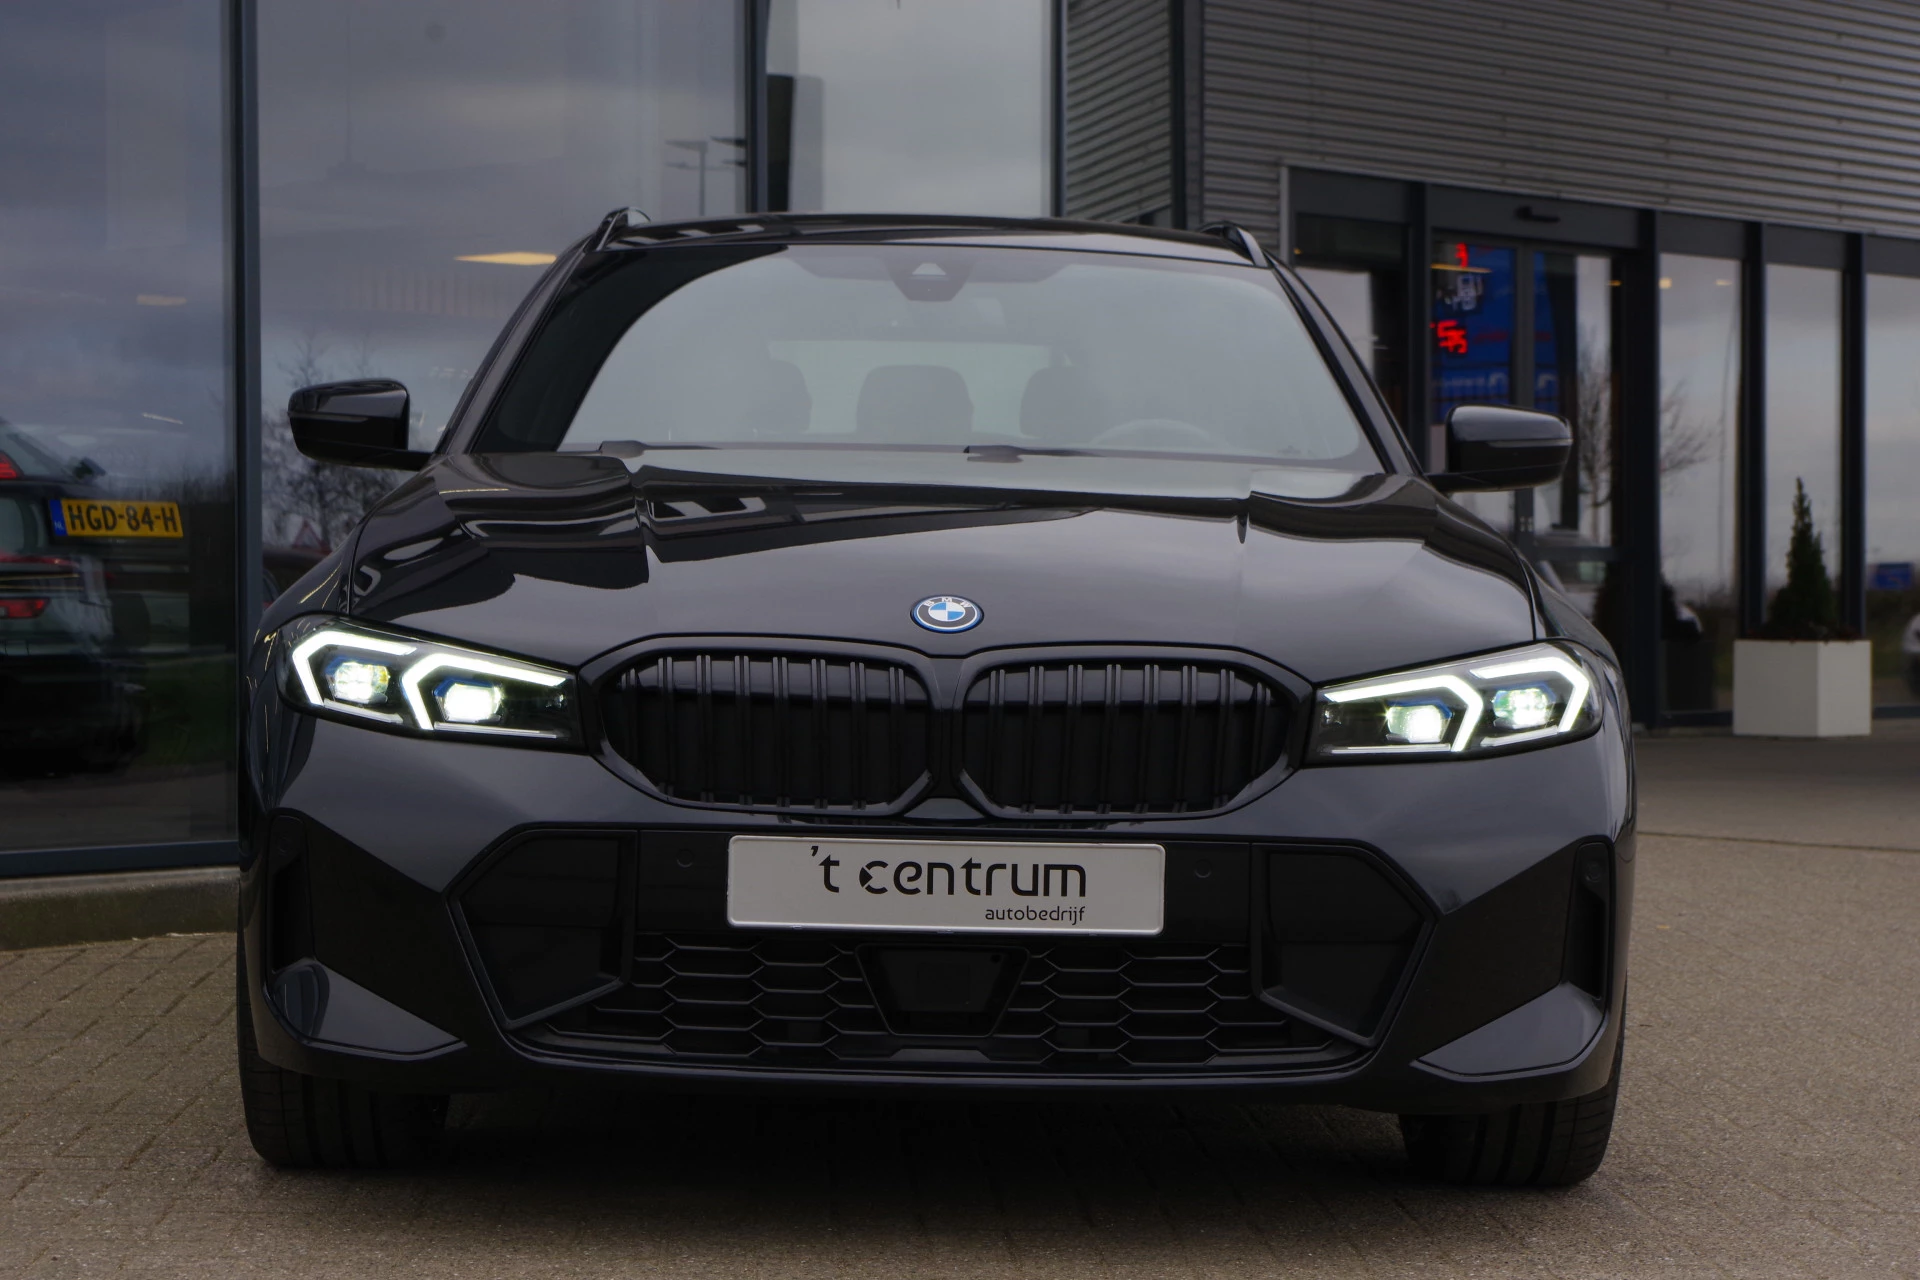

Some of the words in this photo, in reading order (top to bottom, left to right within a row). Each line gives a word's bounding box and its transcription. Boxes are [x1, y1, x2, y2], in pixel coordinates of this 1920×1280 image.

[67, 504, 179, 533] HGD-84-H
[923, 596, 972, 608] BMW
[858, 857, 1087, 897] centrum
[984, 905, 1085, 926] autobedrijf
